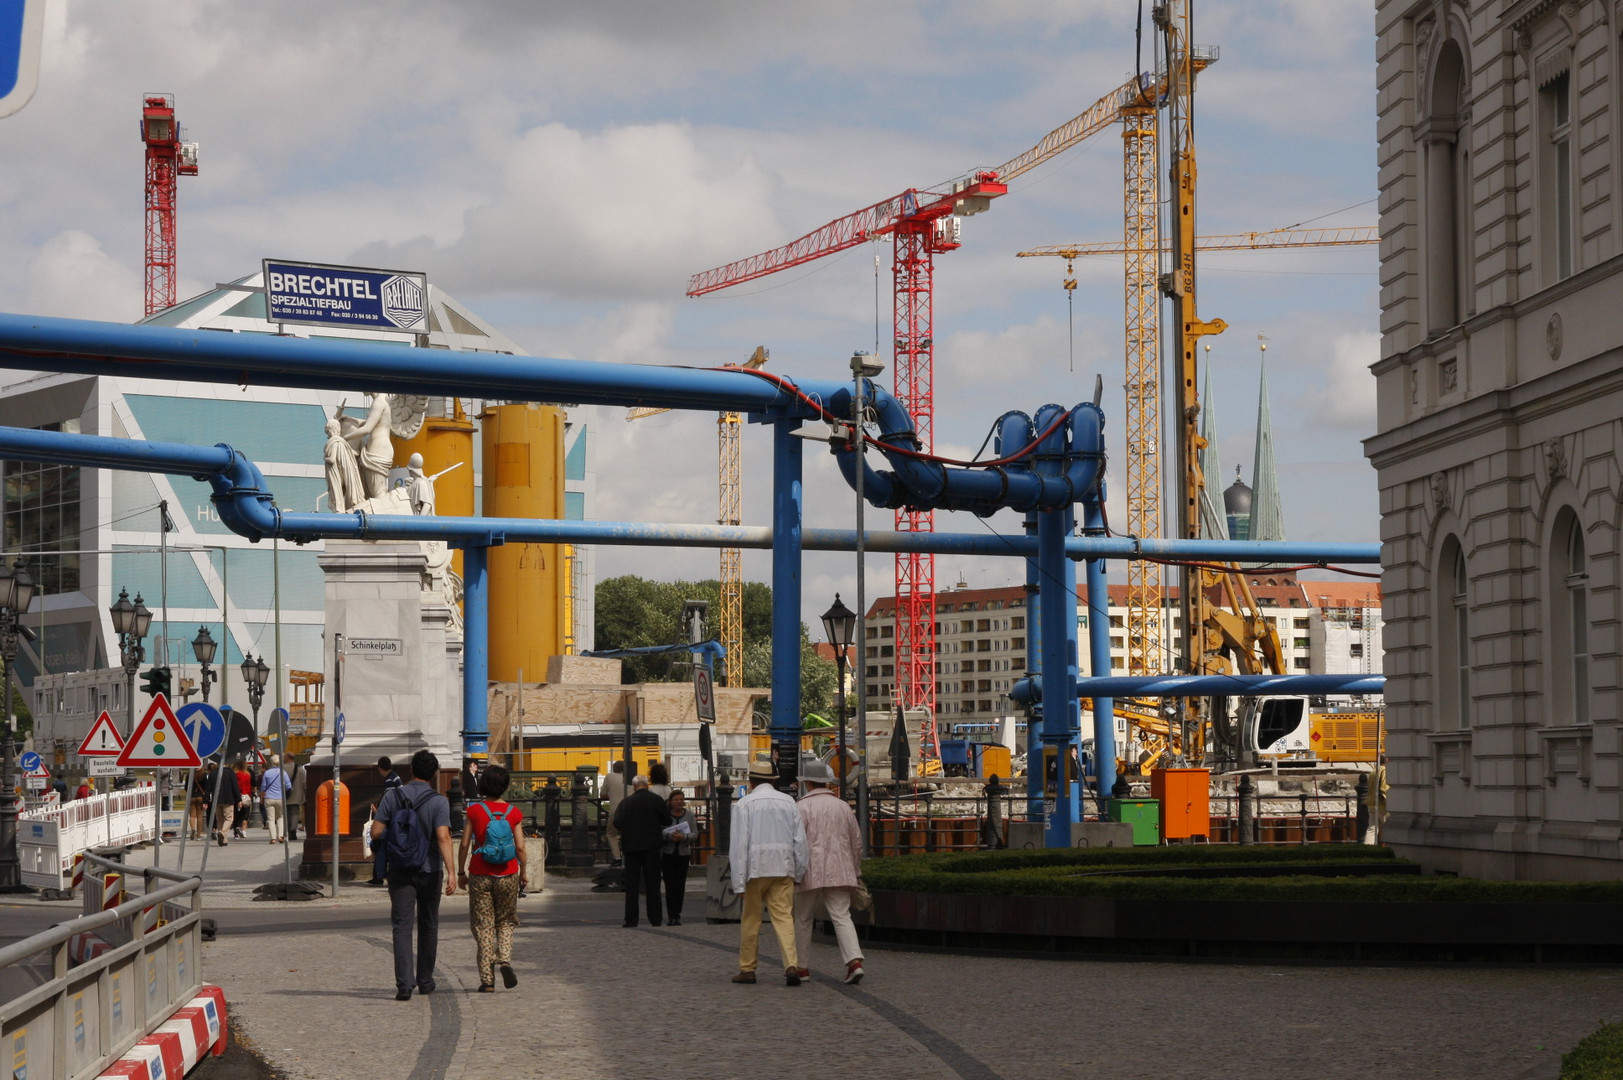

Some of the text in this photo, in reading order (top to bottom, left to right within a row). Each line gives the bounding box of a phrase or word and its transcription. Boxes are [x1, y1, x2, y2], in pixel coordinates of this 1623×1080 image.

[269, 272, 377, 299] BRECHTEL
[1184, 278, 1192, 293] BG
[386, 279, 422, 310] BRECHTEL
[271, 295, 351, 310] SPEZIALTIEFBAU
[351, 640, 397, 652] Schinkelplatz
